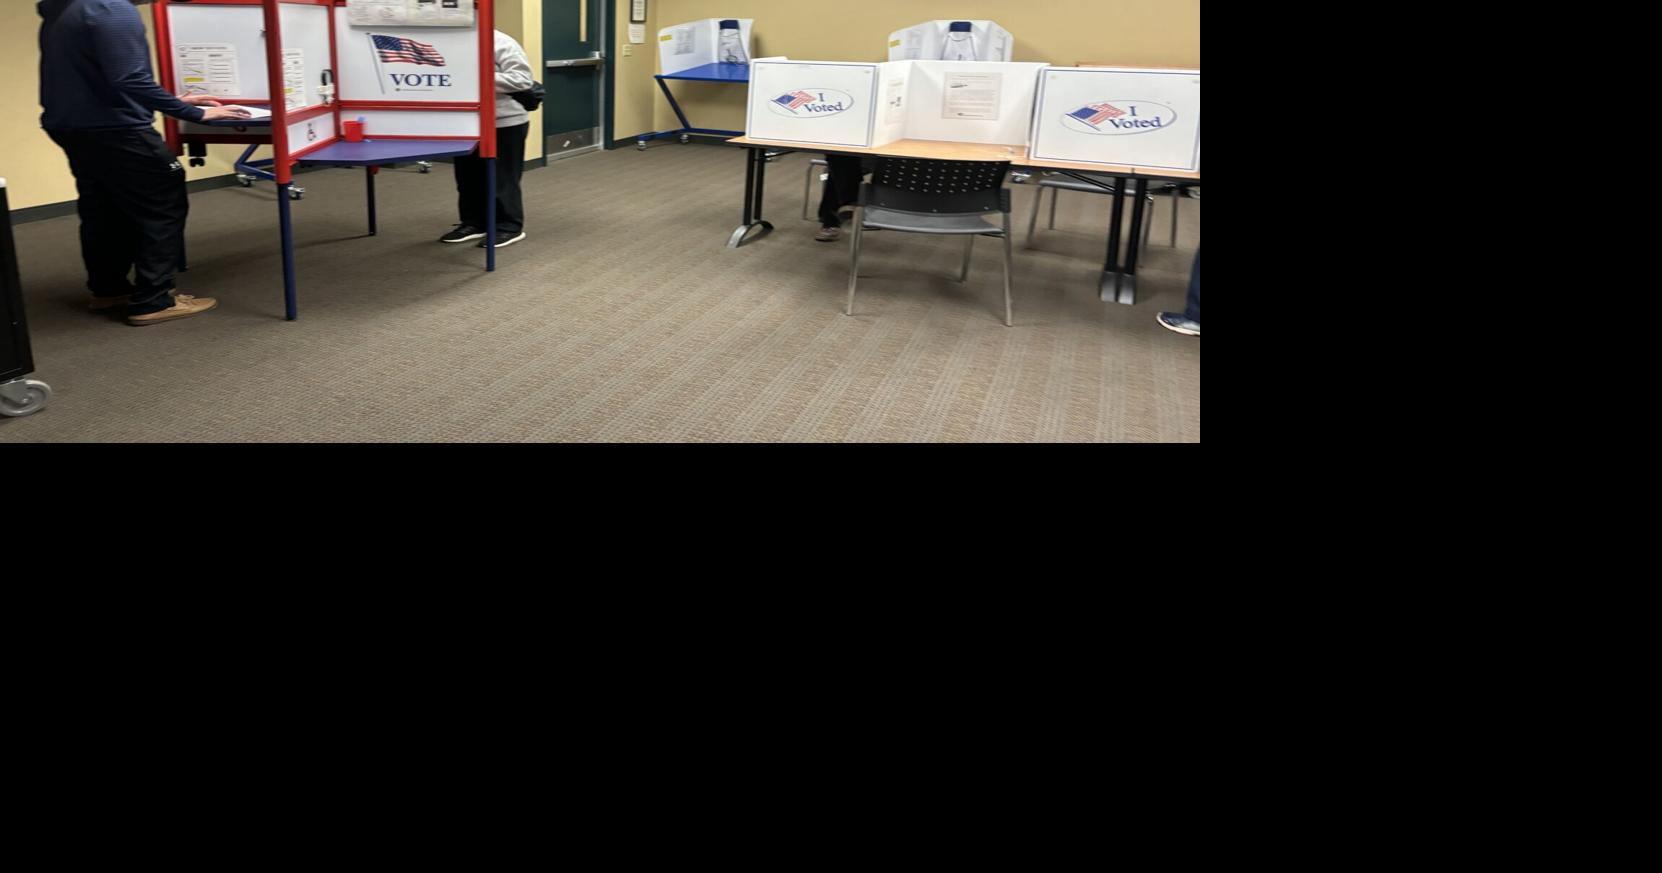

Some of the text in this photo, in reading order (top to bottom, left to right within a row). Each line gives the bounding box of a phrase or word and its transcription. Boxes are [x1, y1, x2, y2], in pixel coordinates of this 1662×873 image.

[389, 74, 452, 87] VOTE
[818, 93, 825, 101] I
[804, 101, 844, 113] Voted
[1129, 106, 1137, 116] I
[1109, 116, 1162, 129] Voted
